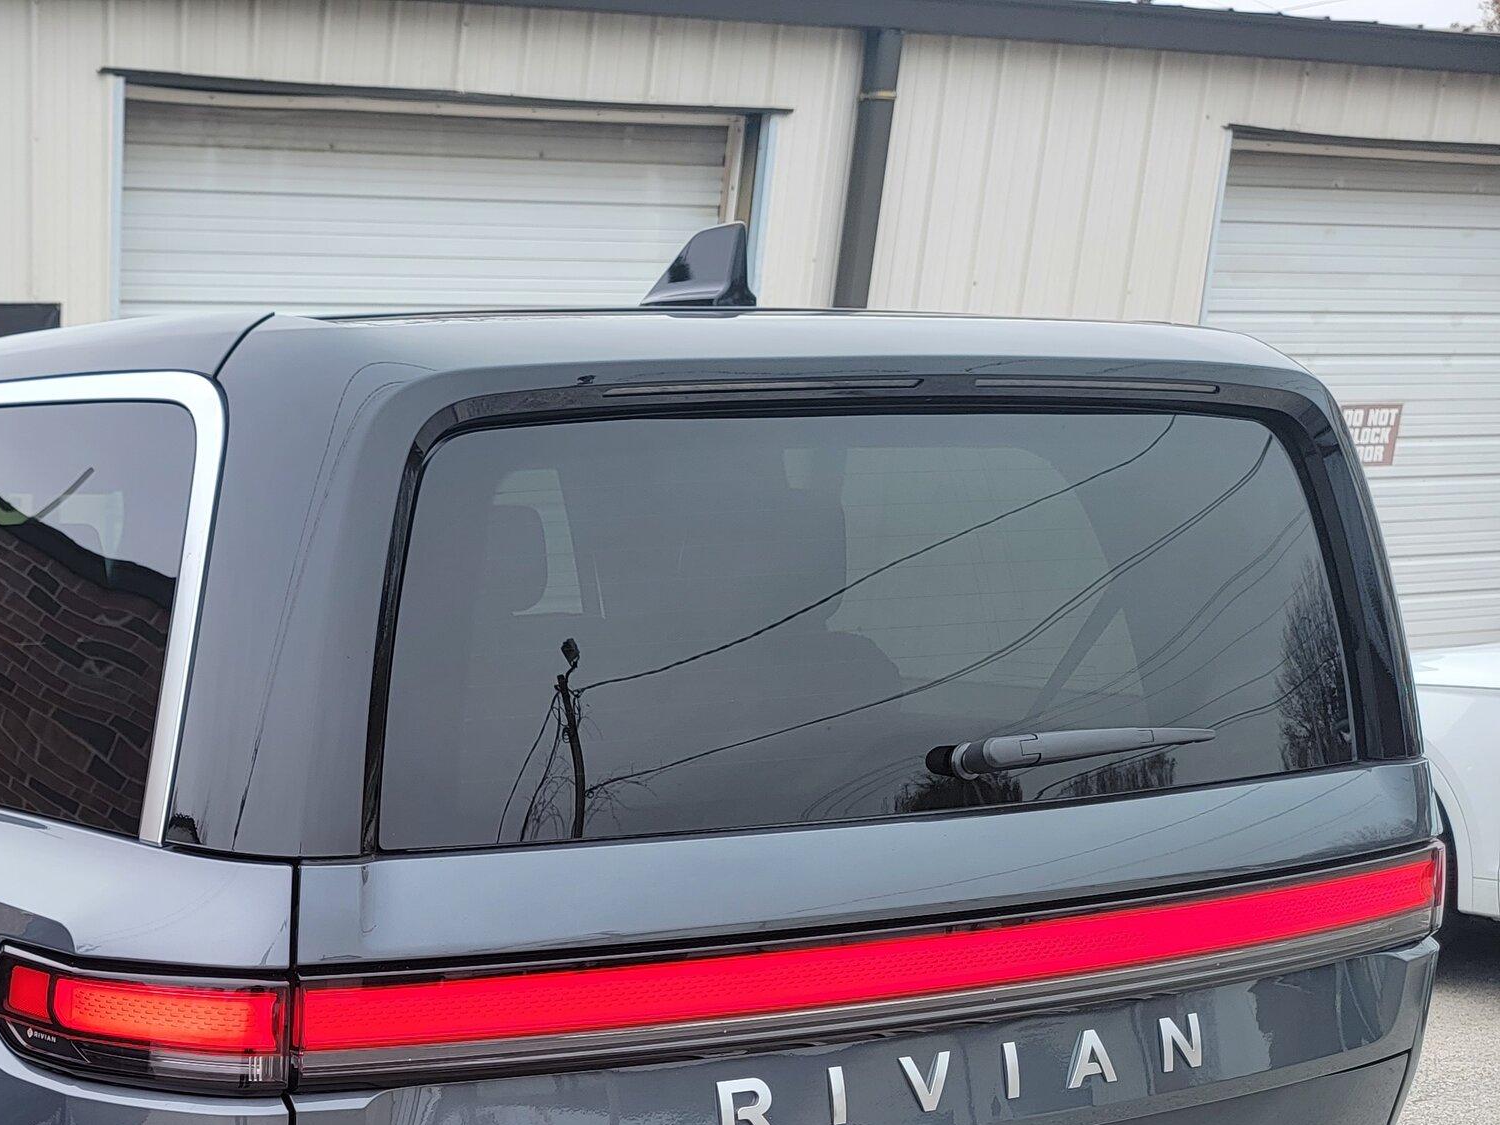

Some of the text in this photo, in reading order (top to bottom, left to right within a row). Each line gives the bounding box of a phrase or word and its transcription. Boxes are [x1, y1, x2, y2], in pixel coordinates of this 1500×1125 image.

[1367, 408, 1399, 426] NOT
[1350, 427, 1391, 444] LOCK
[33, 1030, 57, 1043] RIVIAN
